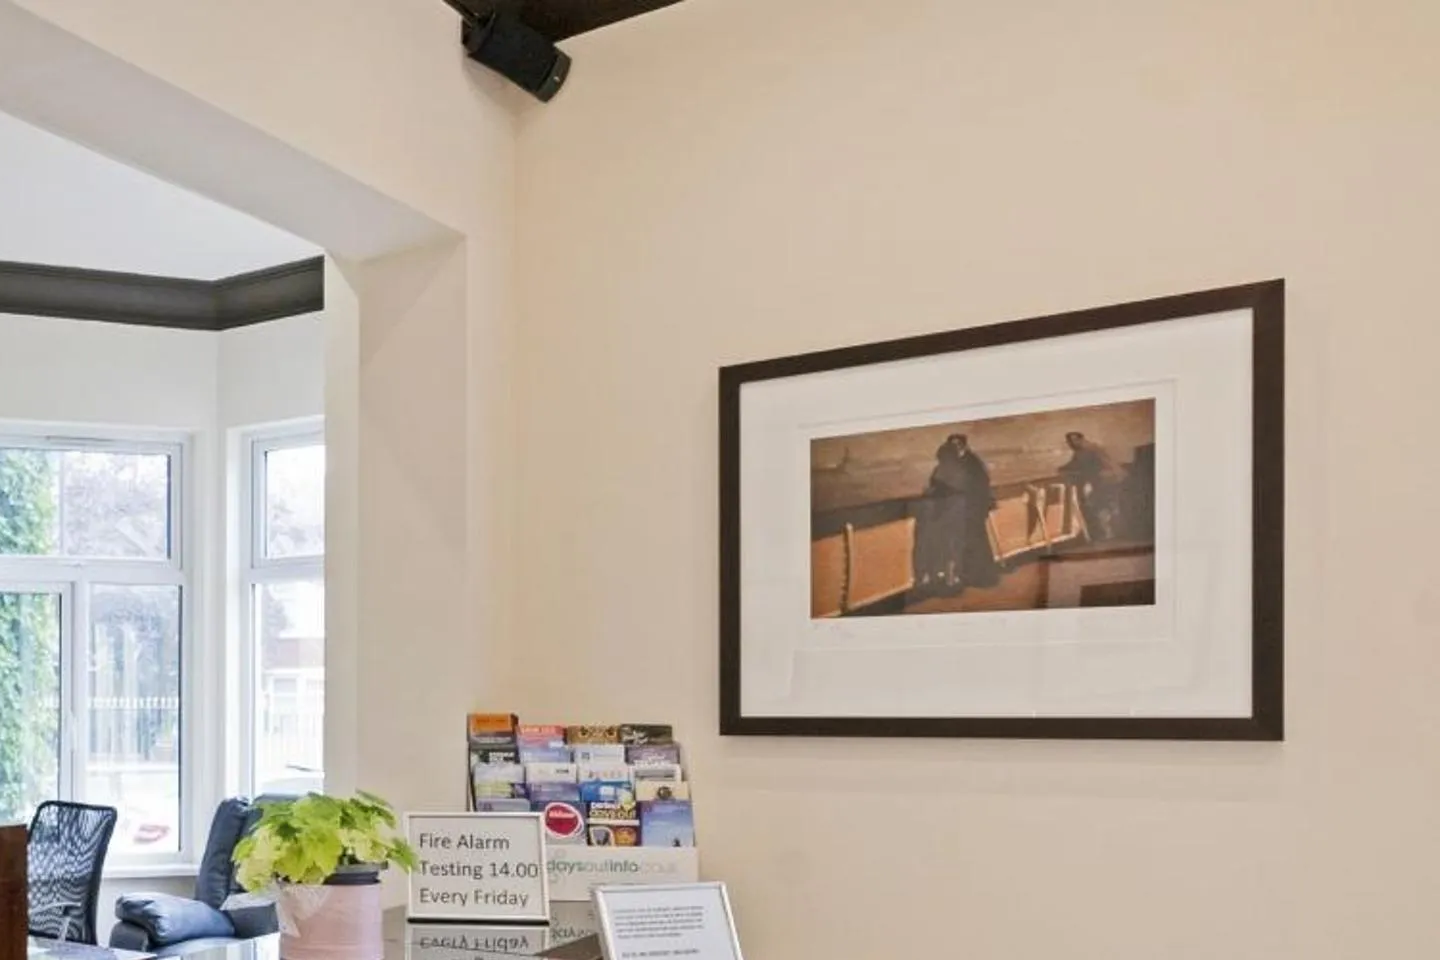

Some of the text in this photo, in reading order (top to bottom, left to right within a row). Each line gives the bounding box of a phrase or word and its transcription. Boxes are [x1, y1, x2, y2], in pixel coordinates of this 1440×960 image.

[419, 833, 510, 850] Fire Alarm
[419, 860, 539, 880] Testing 14.00
[419, 888, 529, 907] Every Friday
